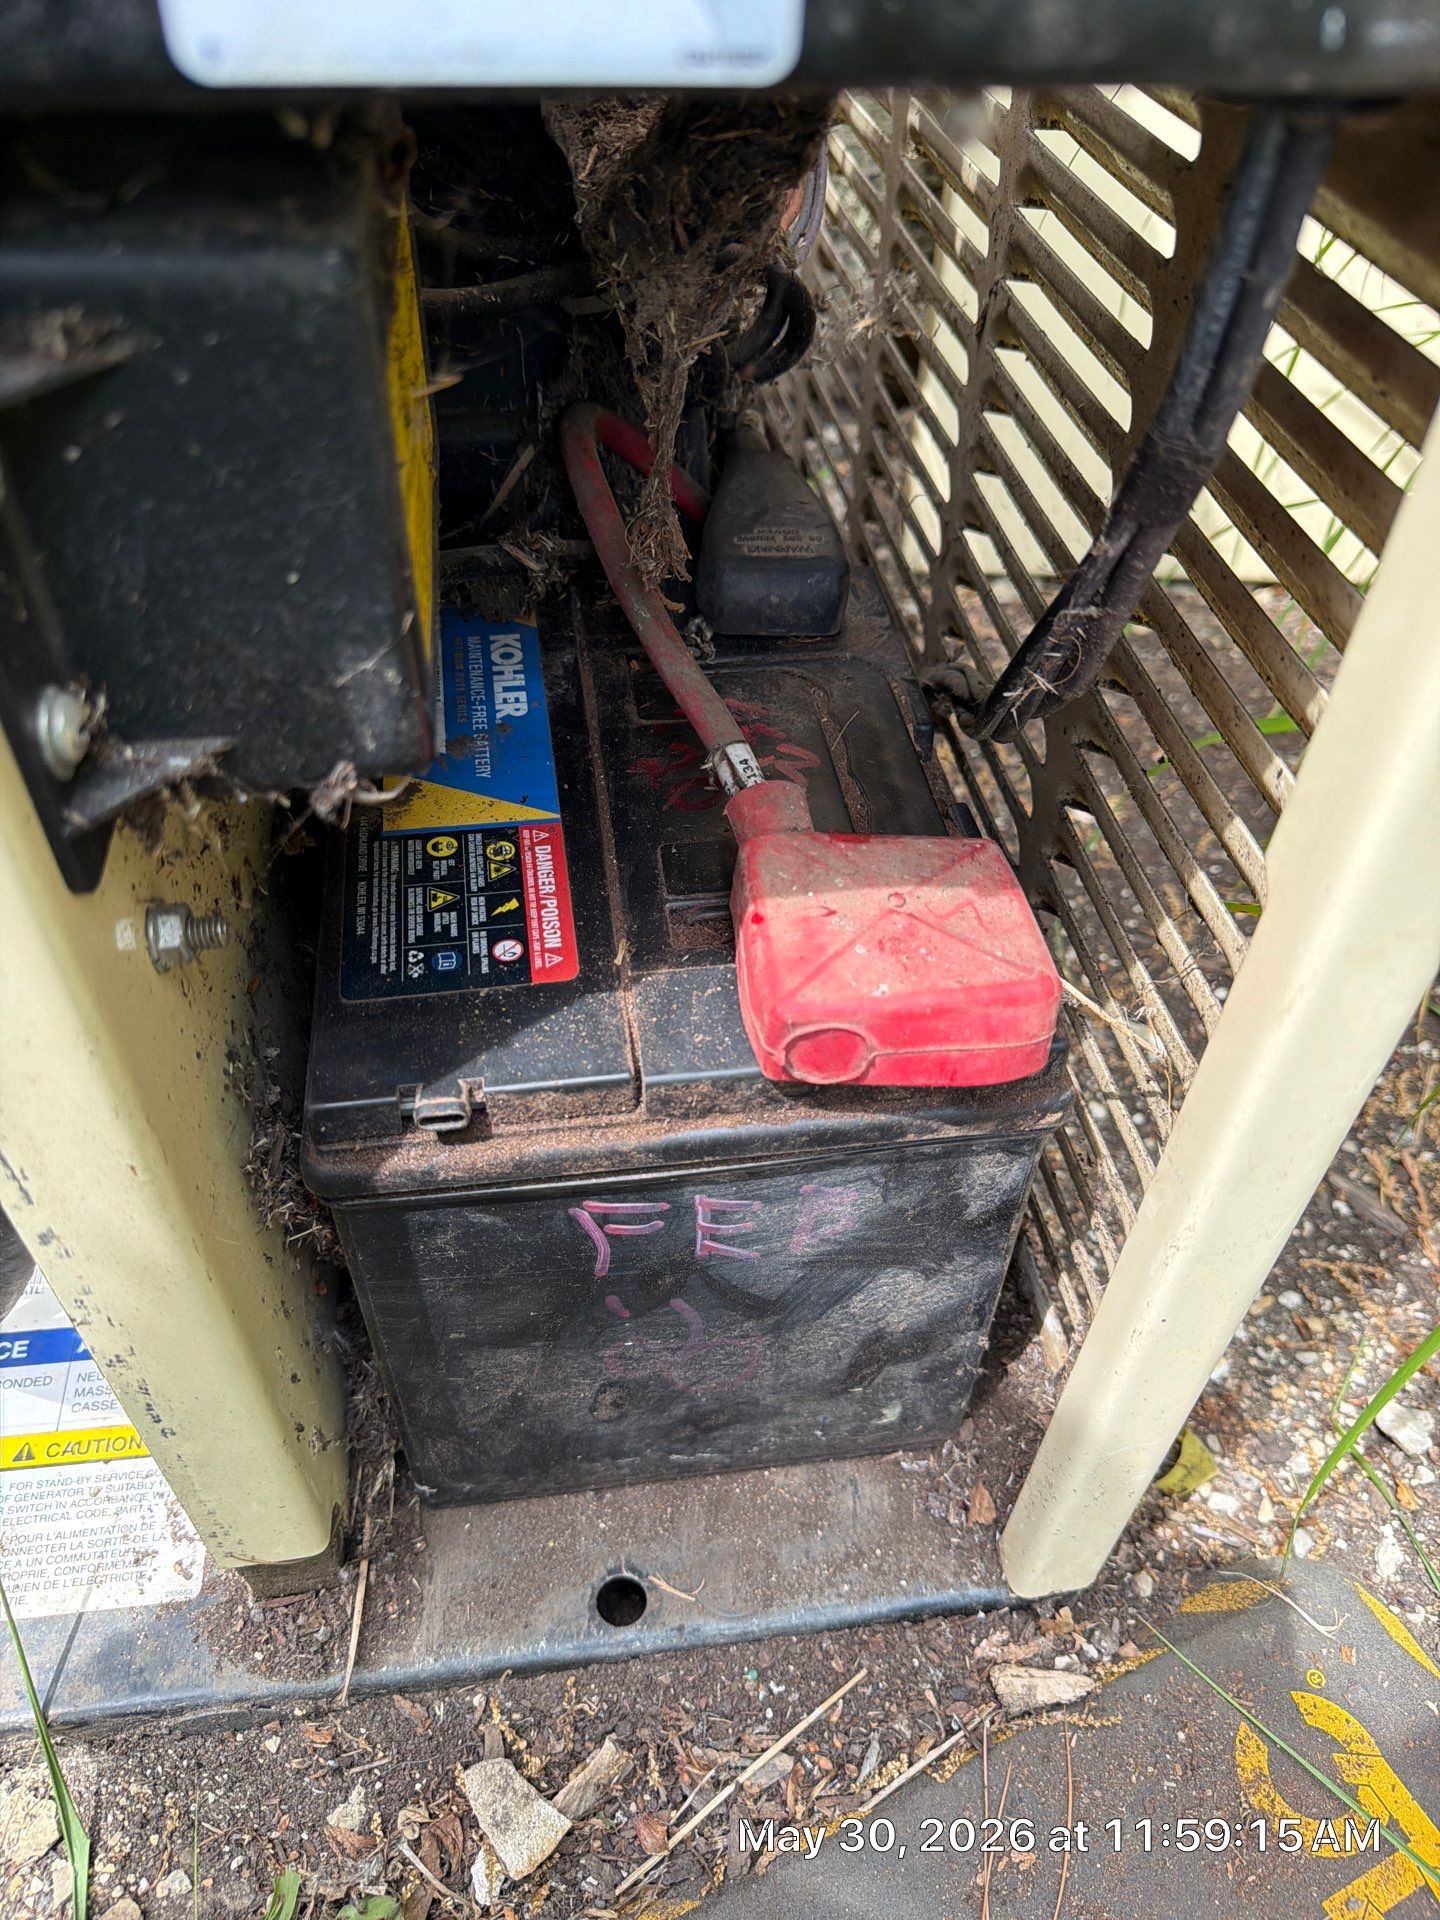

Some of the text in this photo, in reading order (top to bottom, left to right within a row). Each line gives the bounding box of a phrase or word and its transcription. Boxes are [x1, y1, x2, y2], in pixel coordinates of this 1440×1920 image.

[488, 633, 530, 718] KOHLER
[466, 635, 491, 777] MAINTENANCE-FREE BATTERY
[355, 881, 366, 906] KOHLER,
[534, 845, 562, 948] DANGER/POISON
[356, 915, 365, 935] 53044
[46, 1436, 142, 1459] CAUTION
[9, 1482, 32, 1492] FOR
[36, 1475, 91, 1489] STAND-BY
[14, 1487, 83, 1503] GENERATOR
[106, 1480, 156, 1493] SUITABLY
[8, 1502, 52, 1515] SWITCH
[55, 1500, 66, 1509] IN
[2, 1512, 72, 1527] ELECTRICAL
[10, 1521, 156, 1544] POUR L'ALIMENTATION DE
[70, 1541, 83, 1550] LA
[152, 1532, 166, 1541] LA
[26, 1556, 43, 1567] UN
[43, 1579, 59, 1589] DE
